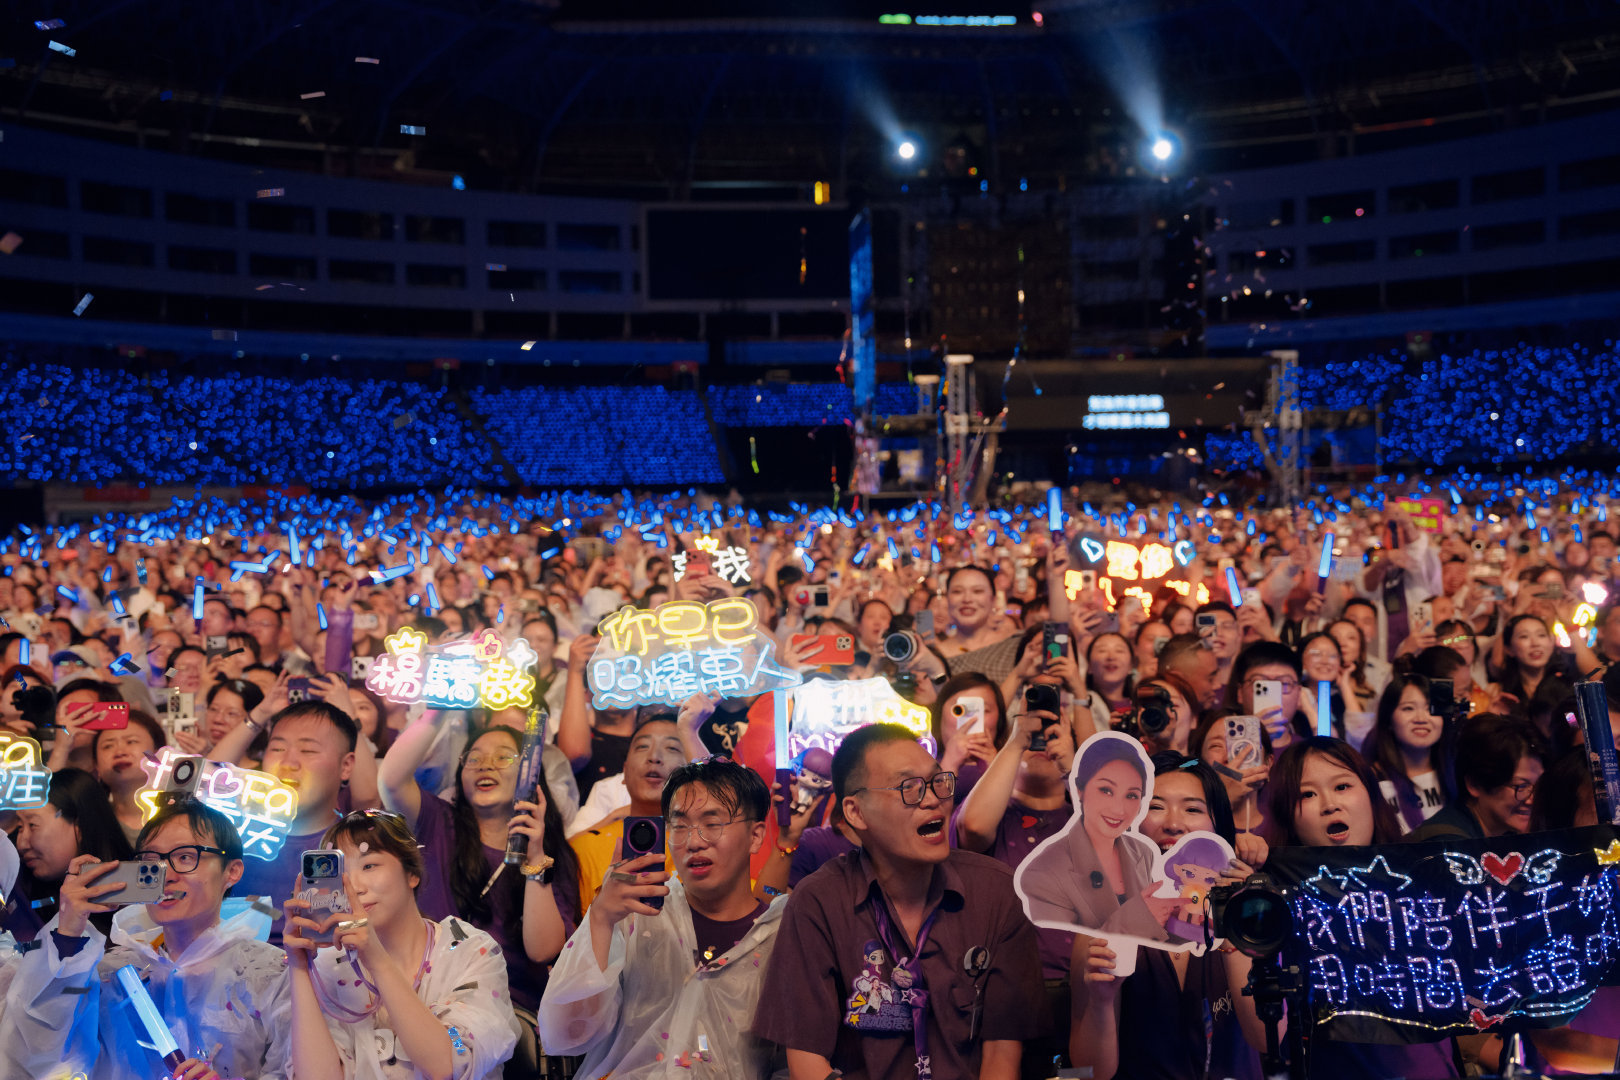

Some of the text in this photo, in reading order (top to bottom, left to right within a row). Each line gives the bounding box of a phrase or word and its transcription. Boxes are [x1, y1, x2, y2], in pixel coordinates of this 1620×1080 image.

[603, 601, 757, 656] 你早已
[371, 653, 530, 703] 楊驕傲
[593, 643, 801, 703] 照耀萬人
[241, 774, 293, 816] Fa
